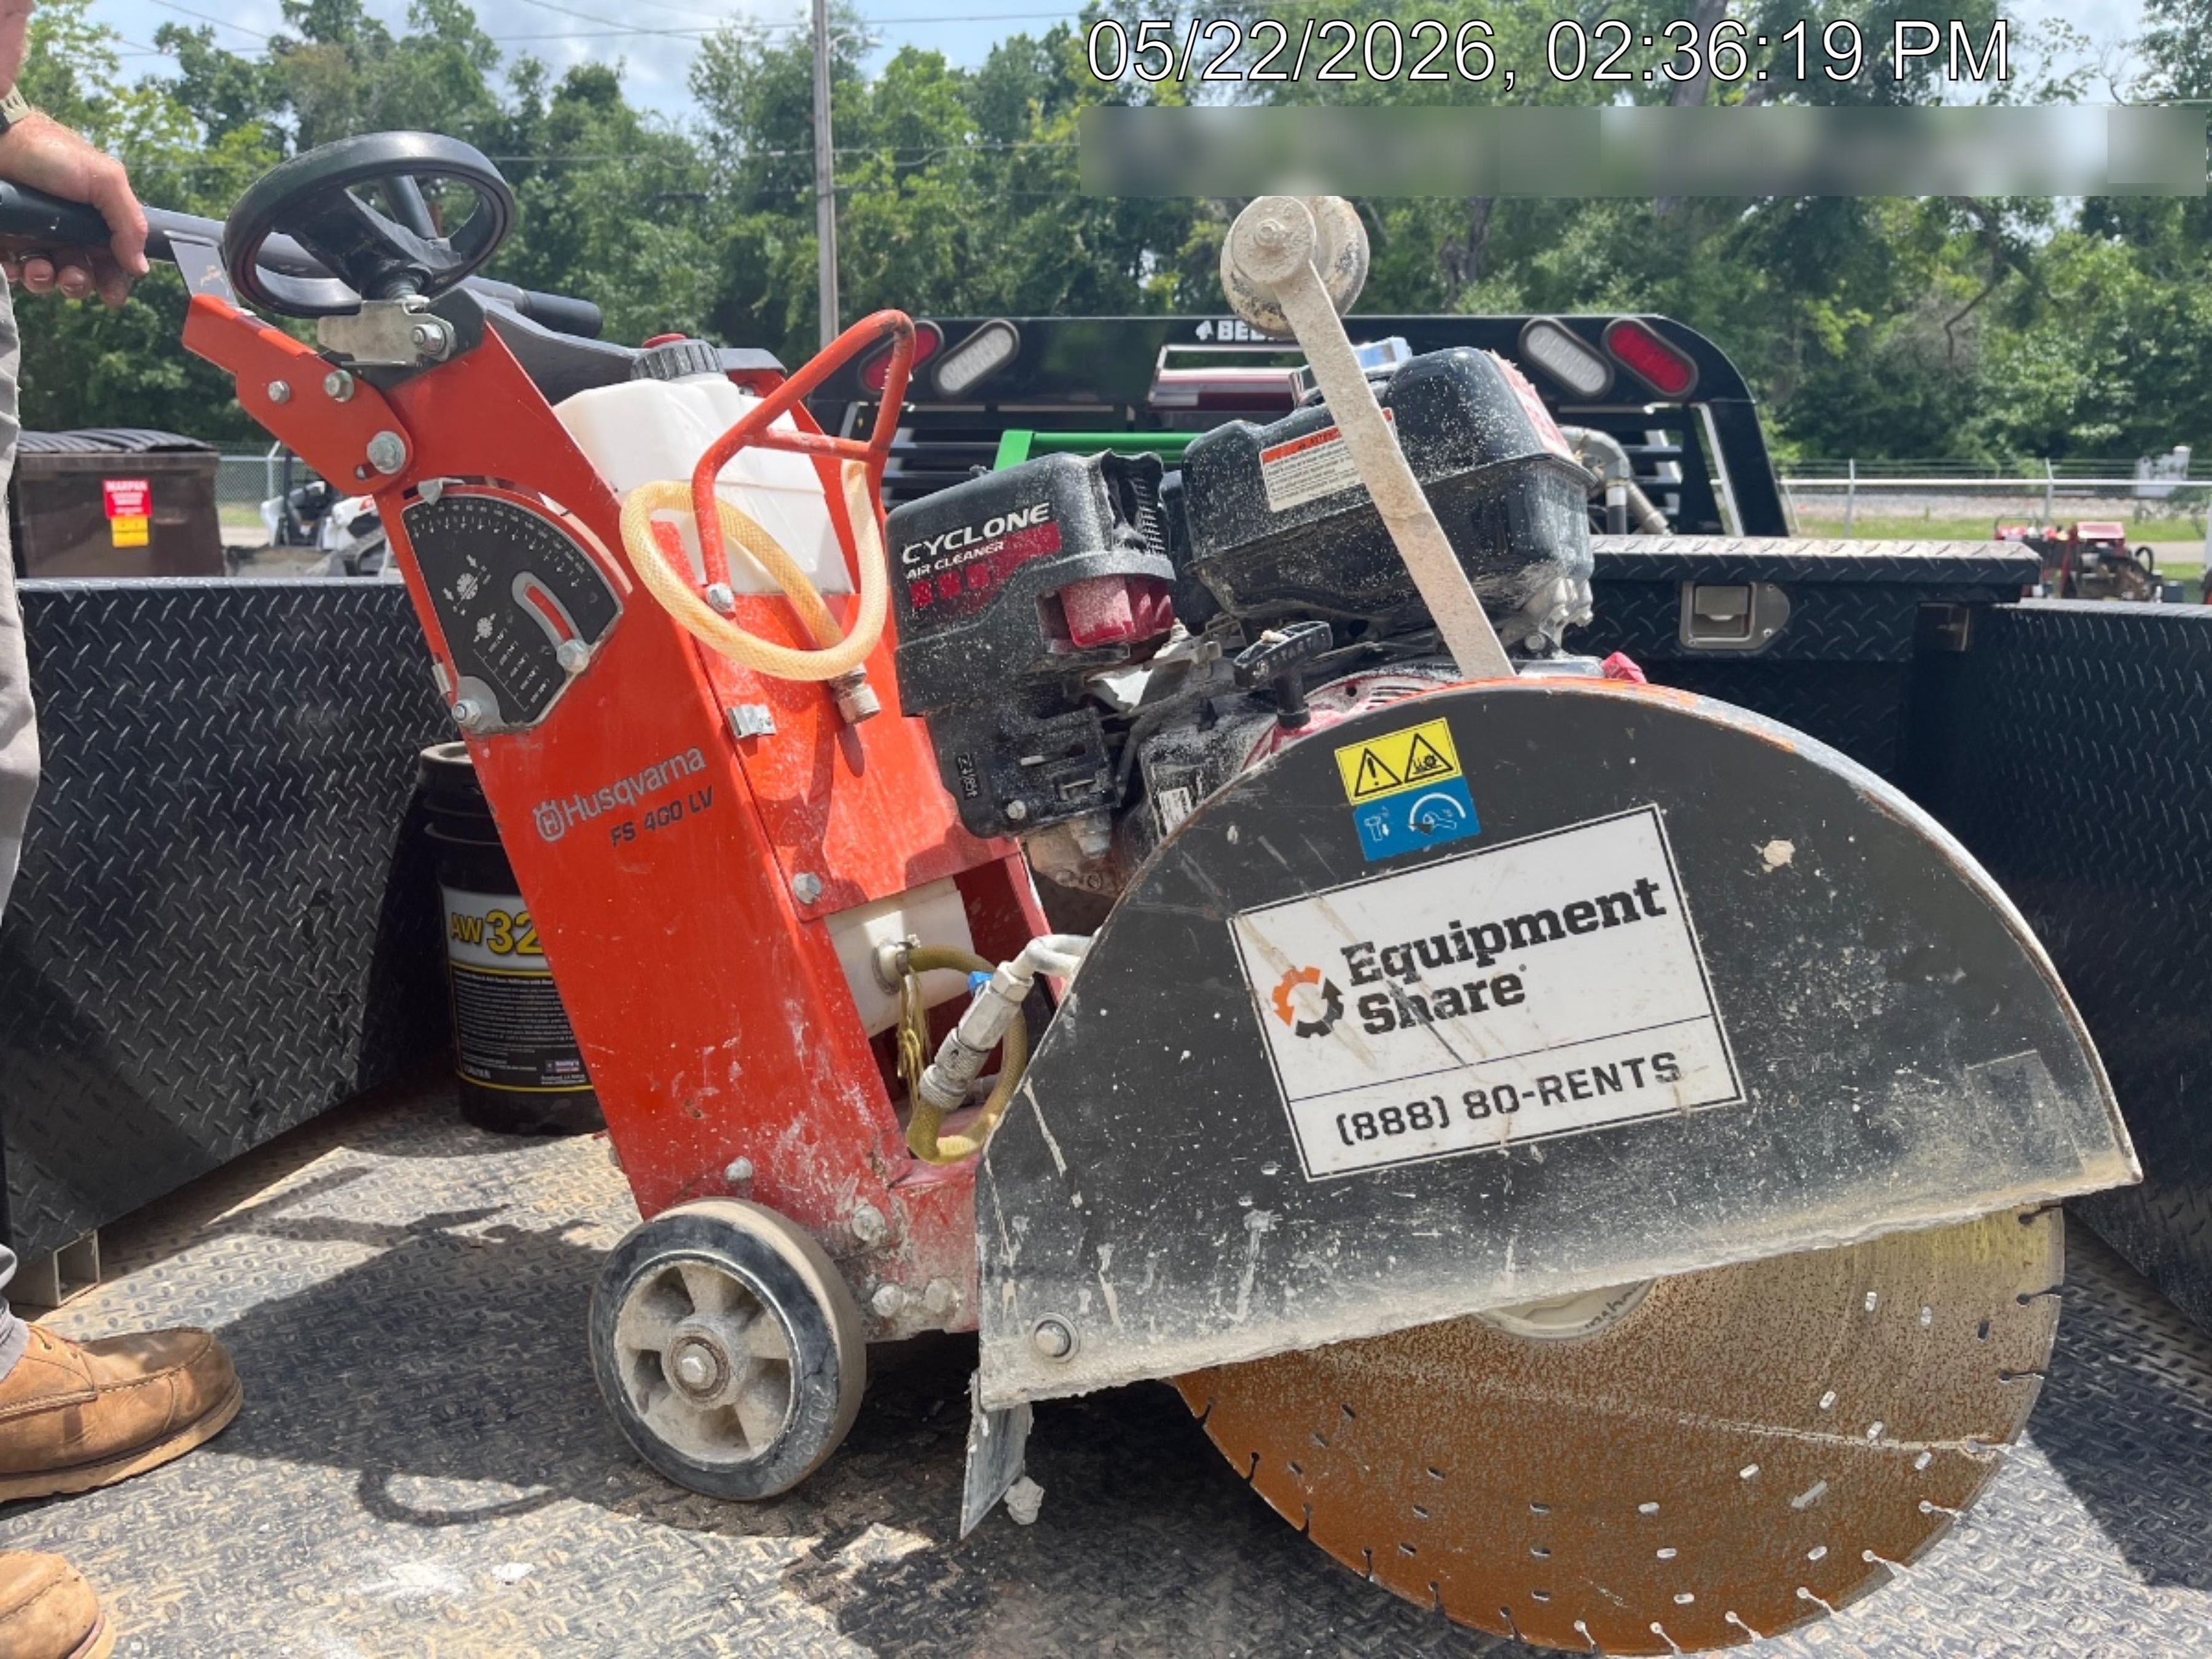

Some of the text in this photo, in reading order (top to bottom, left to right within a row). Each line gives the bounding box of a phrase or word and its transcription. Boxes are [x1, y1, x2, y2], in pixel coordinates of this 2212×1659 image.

[902, 502, 1050, 564] CYCLONE
[906, 541, 1004, 579] AIR CLEANER
[562, 746, 707, 826] Husqvarna
[611, 785, 713, 847] FS 400 LV
[1339, 877, 1667, 985] Equipment
[1357, 973, 1525, 1035] Share
[1336, 1051, 1681, 1145] (888) 80-RENTS
